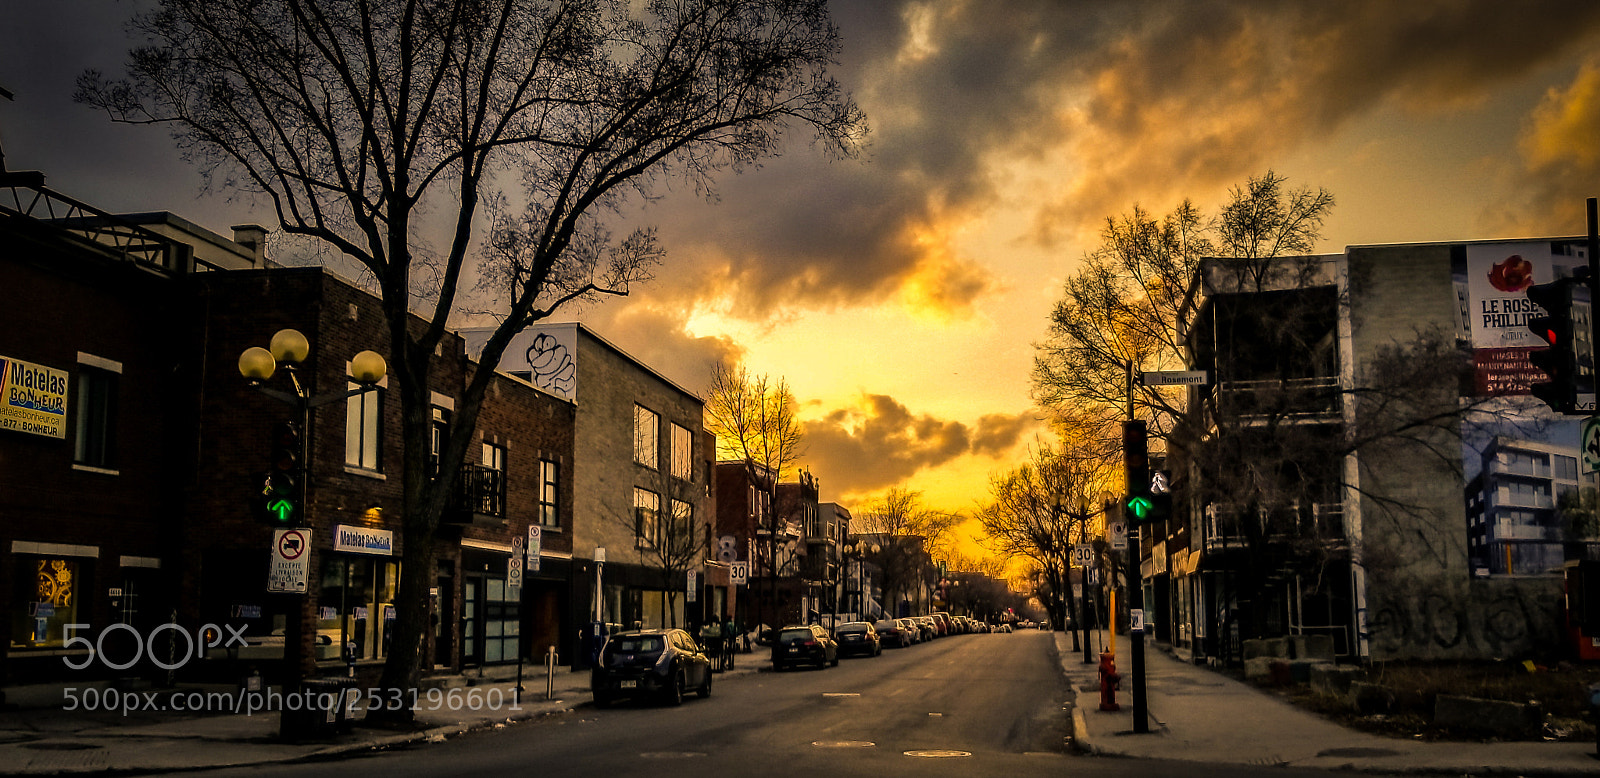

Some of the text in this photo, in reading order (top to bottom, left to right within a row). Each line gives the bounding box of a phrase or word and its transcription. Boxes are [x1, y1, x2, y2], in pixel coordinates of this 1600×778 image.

[1482, 298, 1538, 314] LE ROSE
[11, 362, 65, 396] Matelas
[1161, 376, 1203, 384] Rosemont
[10, 387, 64, 411] BONHEUR
[0, 407, 60, 426] atelasbonheur.ca
[22, 421, 58, 436] BONHEUR
[340, 530, 365, 548] Matelas
[1076, 548, 1091, 560] 30
[731, 566, 745, 578] 30
